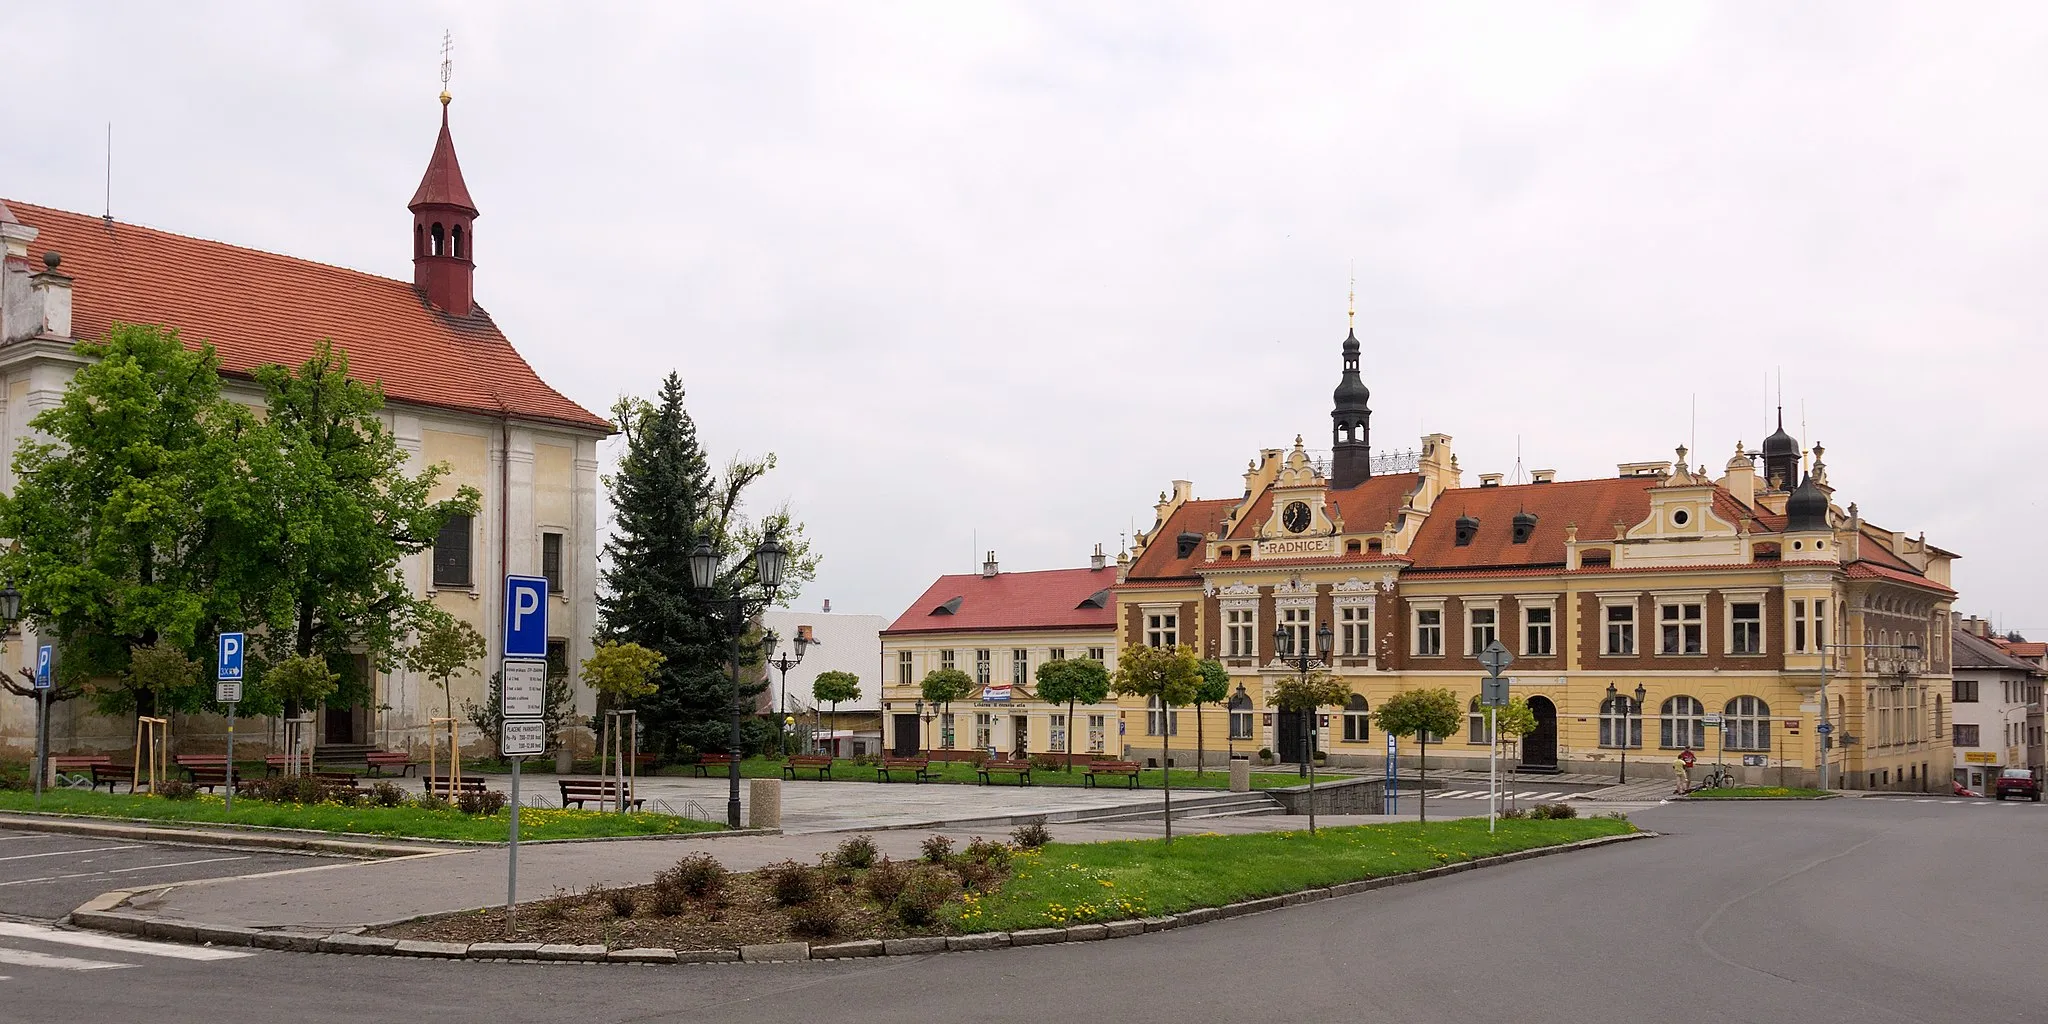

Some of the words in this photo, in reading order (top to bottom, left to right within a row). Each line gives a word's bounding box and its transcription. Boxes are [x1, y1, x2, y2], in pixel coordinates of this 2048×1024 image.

[1269, 541, 1325, 553] RADNICE
[514, 586, 539, 632] P
[38, 650, 49, 675] P
[223, 638, 238, 665] P
